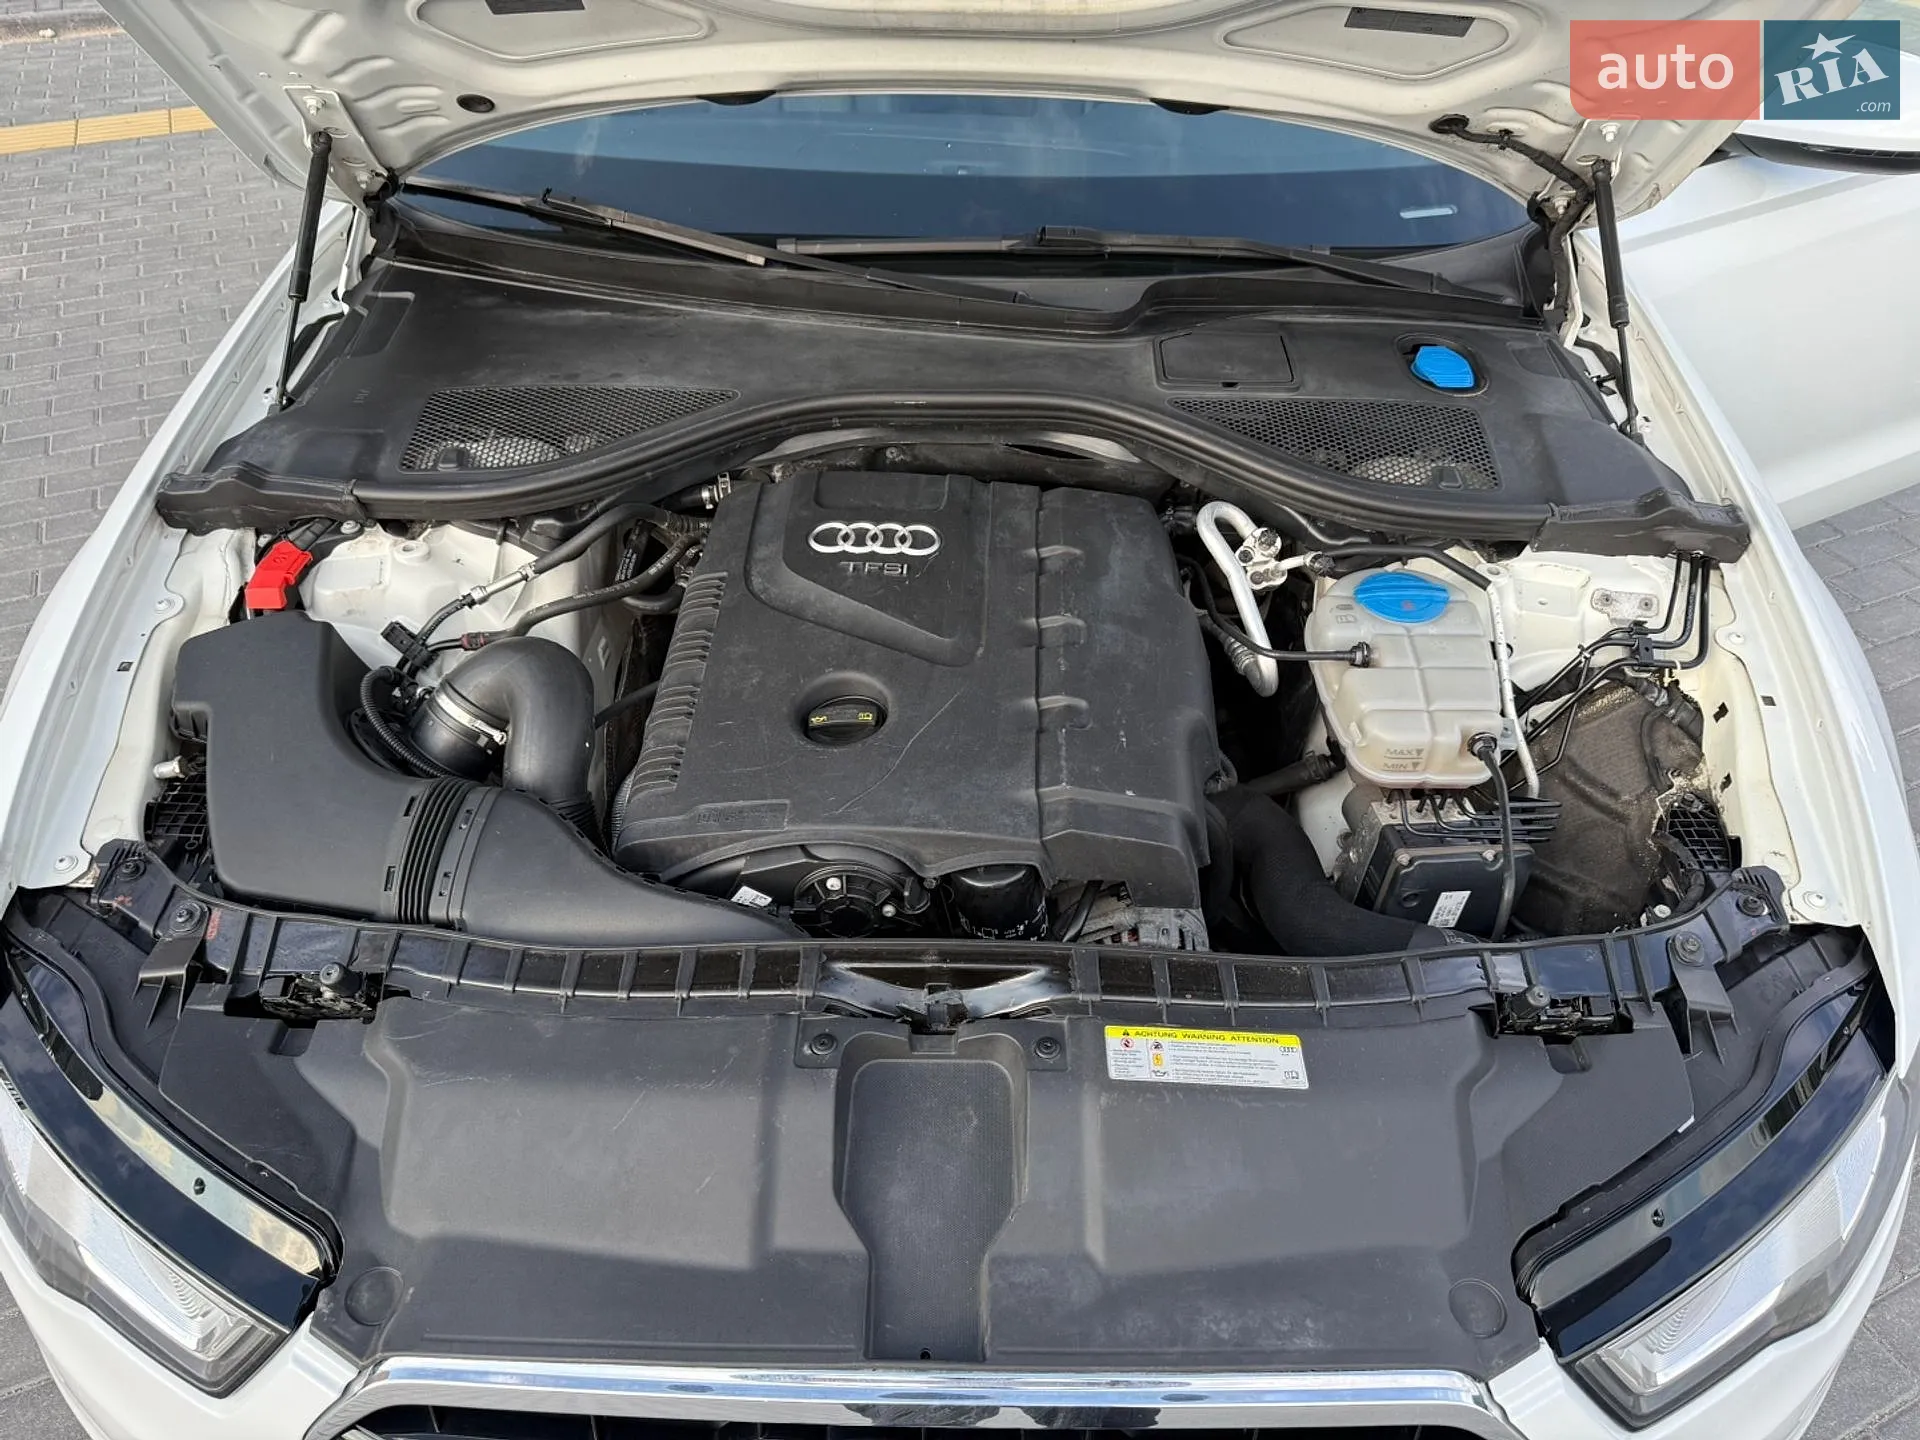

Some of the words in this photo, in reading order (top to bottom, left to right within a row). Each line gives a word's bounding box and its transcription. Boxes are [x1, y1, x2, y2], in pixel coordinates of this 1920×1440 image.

[840, 561, 908, 577] TFSI
[1134, 1031, 1177, 1039] ACHTUNG
[1181, 1033, 1226, 1041] WARNING
[1230, 1035, 1280, 1044] ATTENTION
